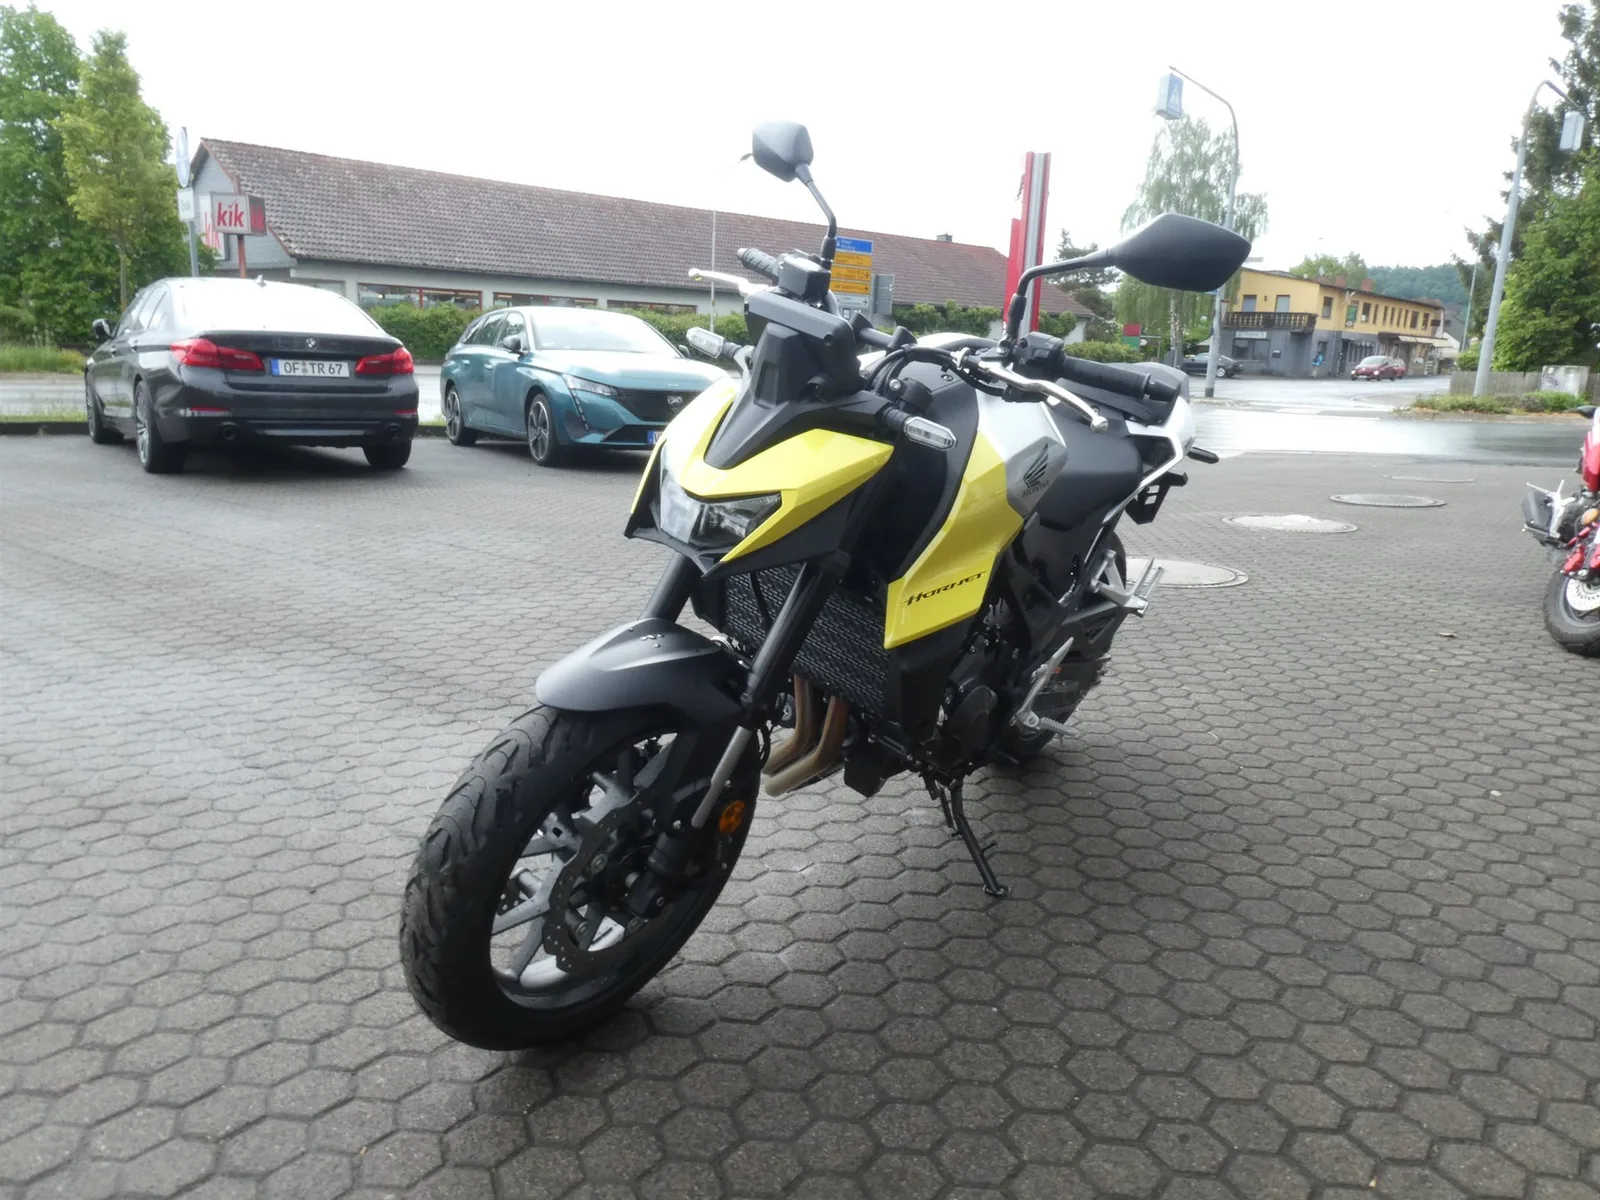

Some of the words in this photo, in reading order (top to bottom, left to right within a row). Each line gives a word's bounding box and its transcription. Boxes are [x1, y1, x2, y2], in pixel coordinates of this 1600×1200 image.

[283, 362, 300, 374] OF
[309, 363, 326, 375] TR
[328, 363, 343, 375] 67
